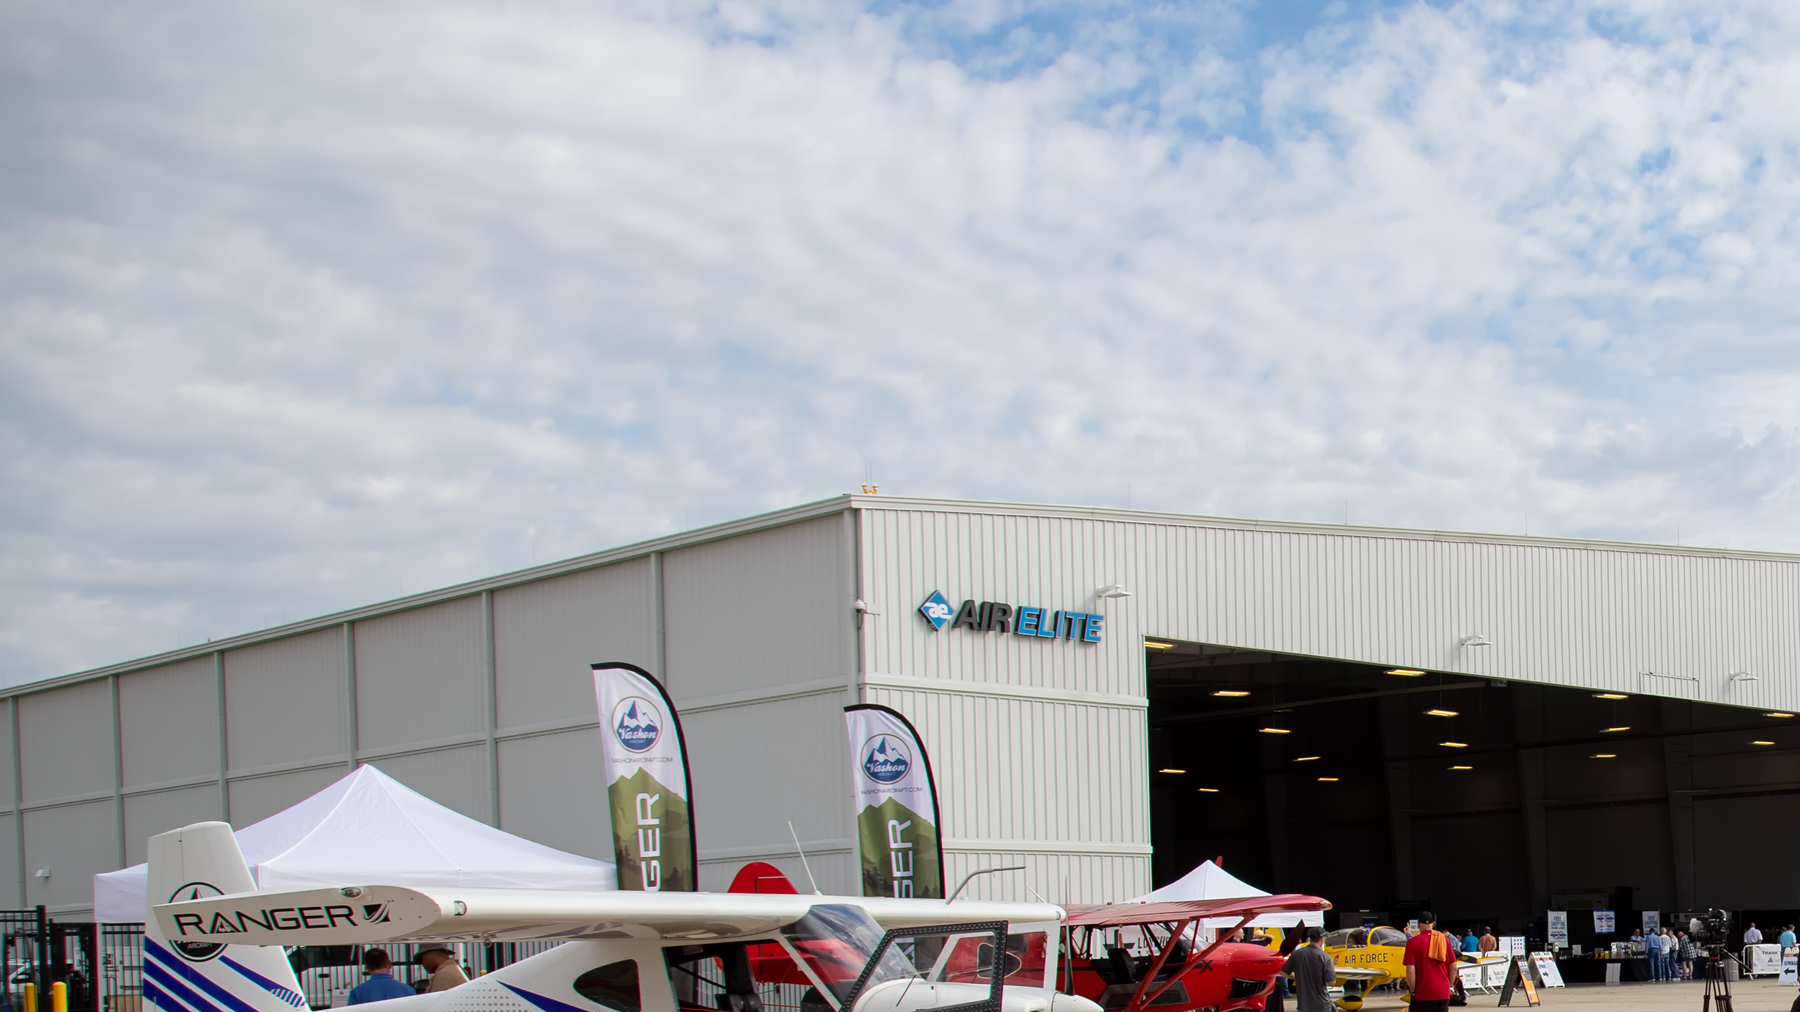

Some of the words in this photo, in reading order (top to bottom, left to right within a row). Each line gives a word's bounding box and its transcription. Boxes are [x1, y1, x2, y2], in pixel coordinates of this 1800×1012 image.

[952, 599, 1013, 633] AIR
[1015, 606, 1105, 643] ELITE
[617, 726, 658, 740] Vashon
[867, 762, 907, 773] Vashon
[173, 904, 359, 936] RANGER
[1344, 954, 1357, 964] AIR
[1360, 952, 1388, 964] FORCE
